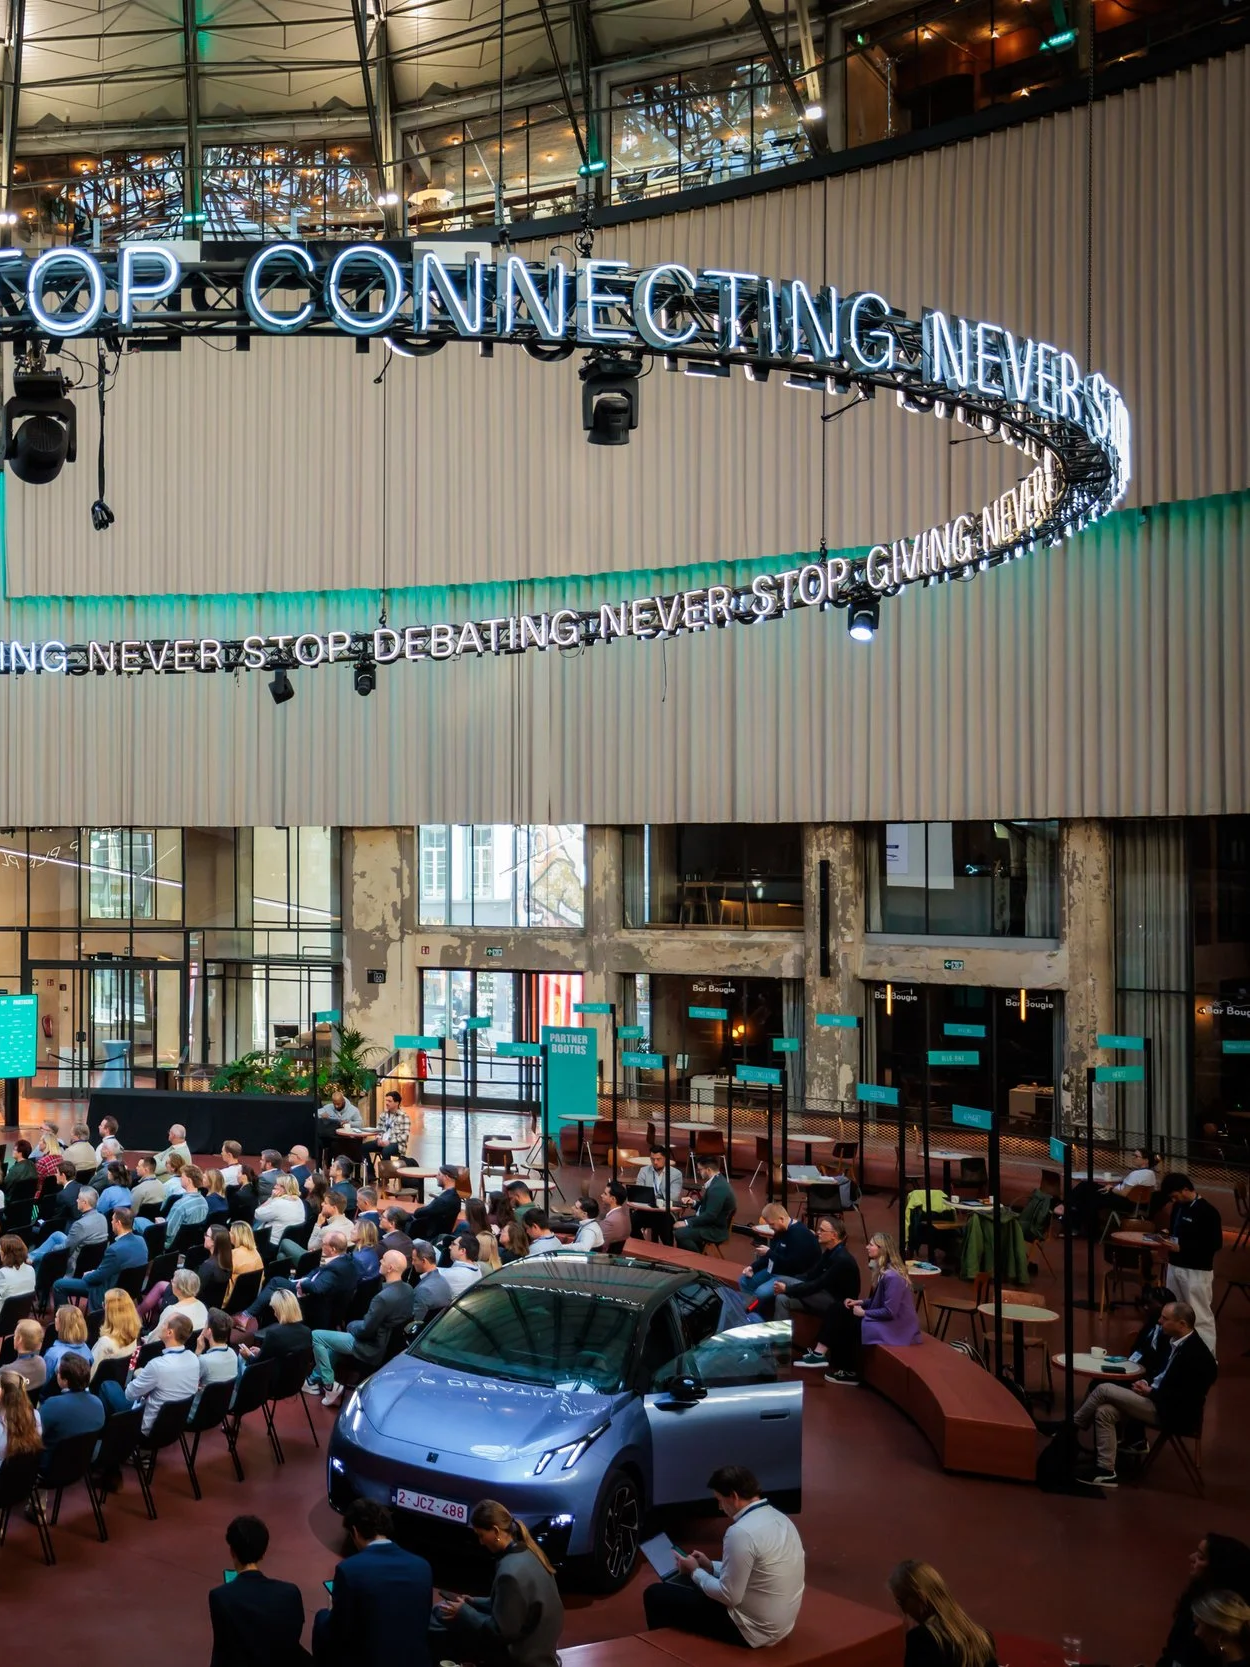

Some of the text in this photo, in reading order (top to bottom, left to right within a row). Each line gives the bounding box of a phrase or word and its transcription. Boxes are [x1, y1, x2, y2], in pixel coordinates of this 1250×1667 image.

[246, 243, 896, 370] CONNECTING
[930, 310, 1084, 422] NEVER
[88, 639, 223, 672] NEVER
[243, 629, 352, 670] STOP
[374, 608, 581, 662] DEBATING
[600, 585, 734, 639] NEVER
[751, 556, 852, 616] STOP
[866, 513, 974, 591] GIVING
[982, 465, 1046, 552] NEVER
[692, 984, 737, 995] Bar Bougie
[874, 990, 887, 999] Ba
[550, 1033, 588, 1045] PARTNER
[551, 1043, 587, 1055] BOOTHS
